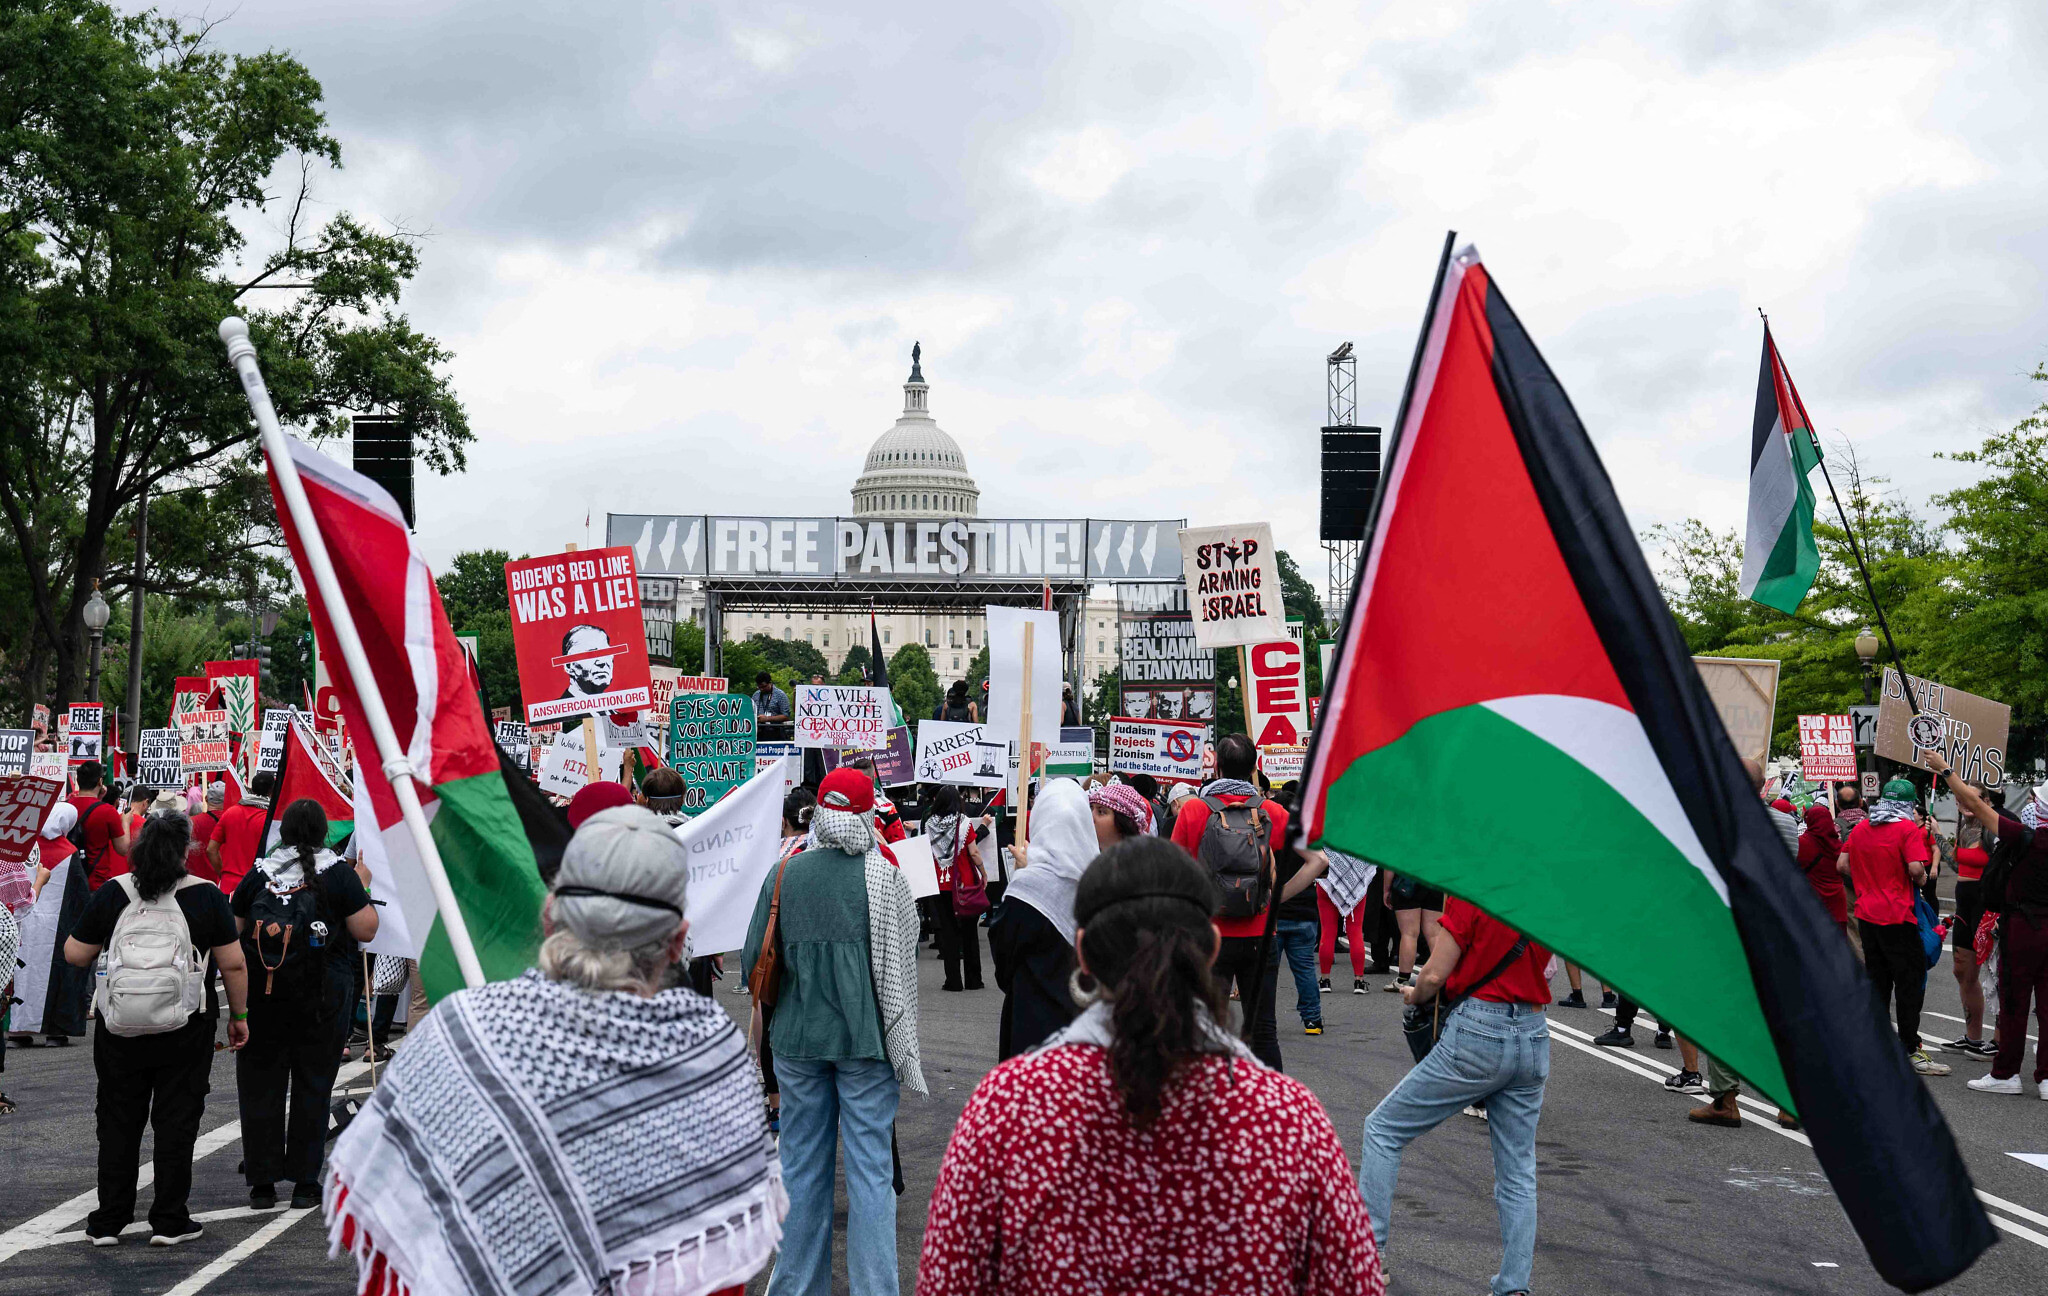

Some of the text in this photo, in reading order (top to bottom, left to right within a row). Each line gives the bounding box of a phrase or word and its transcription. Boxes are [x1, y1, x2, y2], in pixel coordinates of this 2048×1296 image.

[714, 521, 1082, 576] FREE PALESTINE!
[1197, 538, 1258, 570] STP
[511, 555, 631, 591] BIDEN'S RED LINE
[1198, 567, 1261, 595] ARMING
[639, 580, 674, 600] TED
[1121, 584, 1190, 611] WANT
[514, 577, 635, 624] WAS A LIE!
[1121, 621, 1196, 637] WAR CRIMIN
[1122, 660, 1214, 680] NETANYAHU
[652, 679, 673, 691] END
[677, 676, 726, 692] WANTED
[653, 691, 670, 702] ALL
[806, 688, 877, 703] NC WILL
[1251, 641, 1301, 760] CEA
[1883, 669, 1951, 717] ISRAEL
[532, 691, 645, 719] ANSWERCOALITION.ORG
[650, 703, 670, 715] AID
[675, 698, 743, 720] EYES ON
[798, 703, 882, 718] NOT VOTE
[72, 708, 100, 723] FREE
[180, 711, 226, 725] WANTED
[1799, 715, 1852, 730] END ALL
[70, 722, 101, 731] PALESTINE
[265, 722, 273, 731] IS
[500, 722, 528, 738] FREE
[530, 722, 561, 733] WANTED
[677, 719, 724, 738] VOICES
[724, 719, 752, 735] LOUD
[801, 717, 884, 732] GENOCIDE
[1114, 724, 1156, 736] Judaism
[142, 730, 180, 739] STAND WIT
[497, 735, 529, 745] PALESTINE
[824, 731, 857, 740] ARREST
[1114, 736, 1155, 748] Rejects
[1800, 729, 1852, 744] U.S. AID
[0, 735, 28, 750] TOP
[141, 738, 180, 747] PALESTIN
[181, 742, 227, 755] BENJAMIN
[675, 739, 753, 759] HANDS RAISED
[923, 726, 984, 759] ARREST
[1801, 744, 1854, 756] TO ISRAEL
[0, 752, 26, 762] MING
[141, 747, 180, 759] END TH
[260, 747, 281, 758] PEOP
[768, 746, 800, 755] Propaanda
[889, 750, 900, 758] but
[1113, 748, 1155, 760] Zionism
[32, 755, 44, 763] TOP
[181, 752, 228, 765] NETANYAHU
[941, 750, 973, 773] BIBI
[1008, 759, 1020, 768] Isr
[1279, 757, 1304, 765] PALEST
[1803, 756, 1855, 766] STOP THE GENOCIDE
[563, 758, 603, 780] HITLR
[675, 760, 748, 784] ESCALATE
[1113, 760, 1201, 776] And the State of "Israel"
[138, 768, 182, 784] NOW!
[10, 778, 57, 792] THE
[16, 788, 52, 807] ON
[685, 786, 707, 808] OR
[0, 803, 41, 831] ZA
